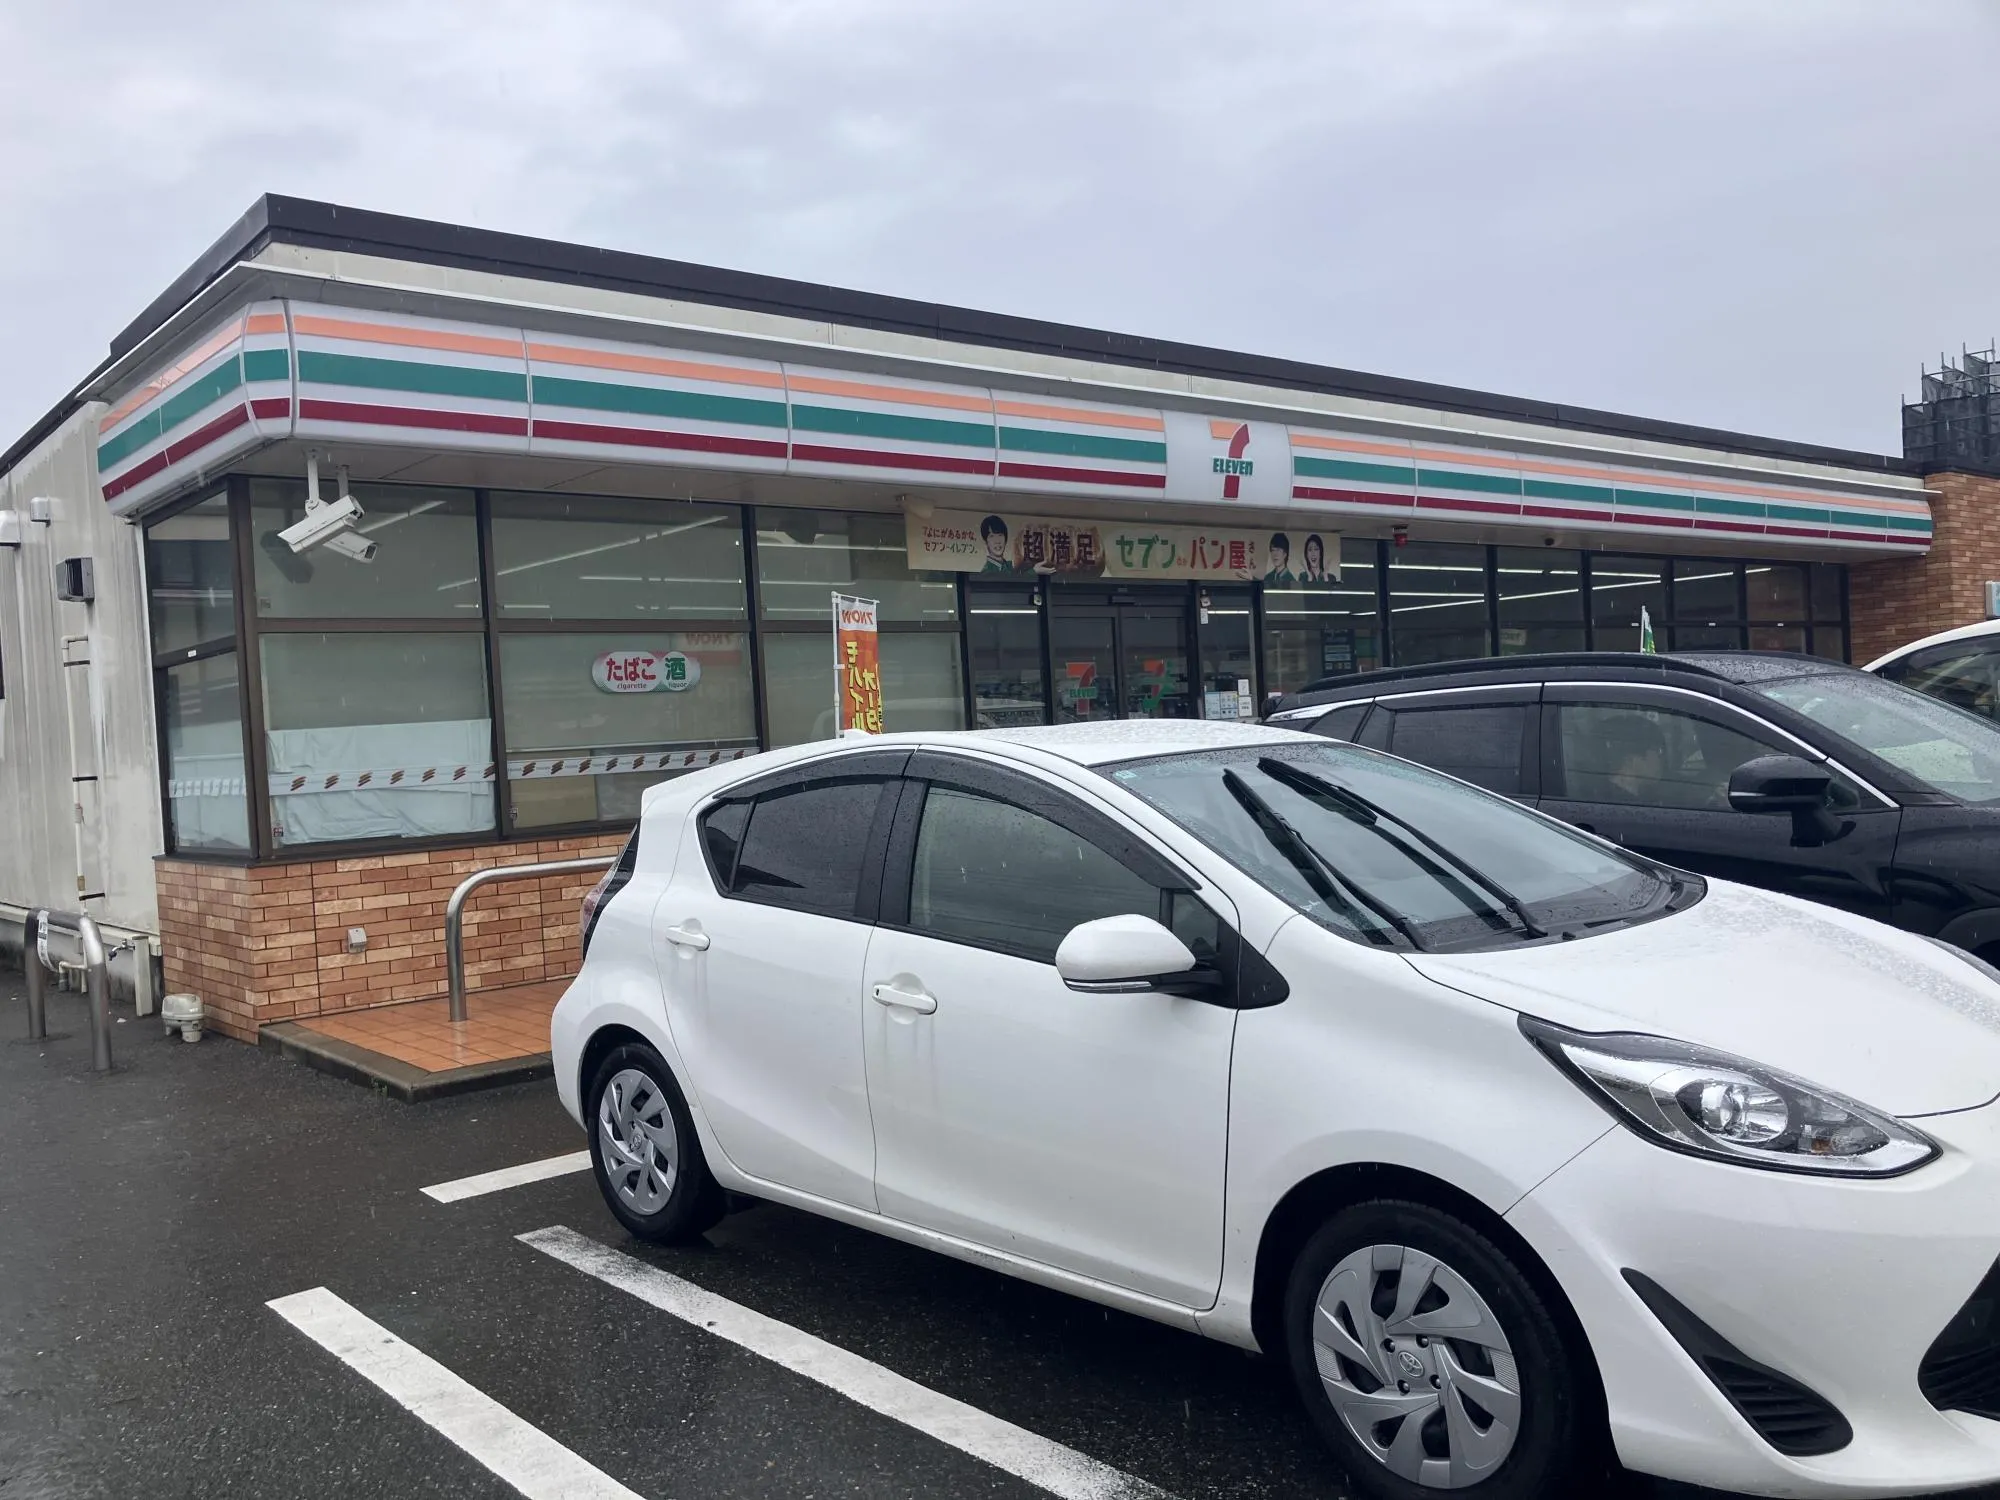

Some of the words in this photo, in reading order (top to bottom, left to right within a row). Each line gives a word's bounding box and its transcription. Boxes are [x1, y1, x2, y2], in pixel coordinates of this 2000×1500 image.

[1209, 420, 1250, 499] 7
[1023, 529, 1096, 566] 超満足
[606, 656, 656, 681] たばこ
[665, 657, 686, 680] 酒
